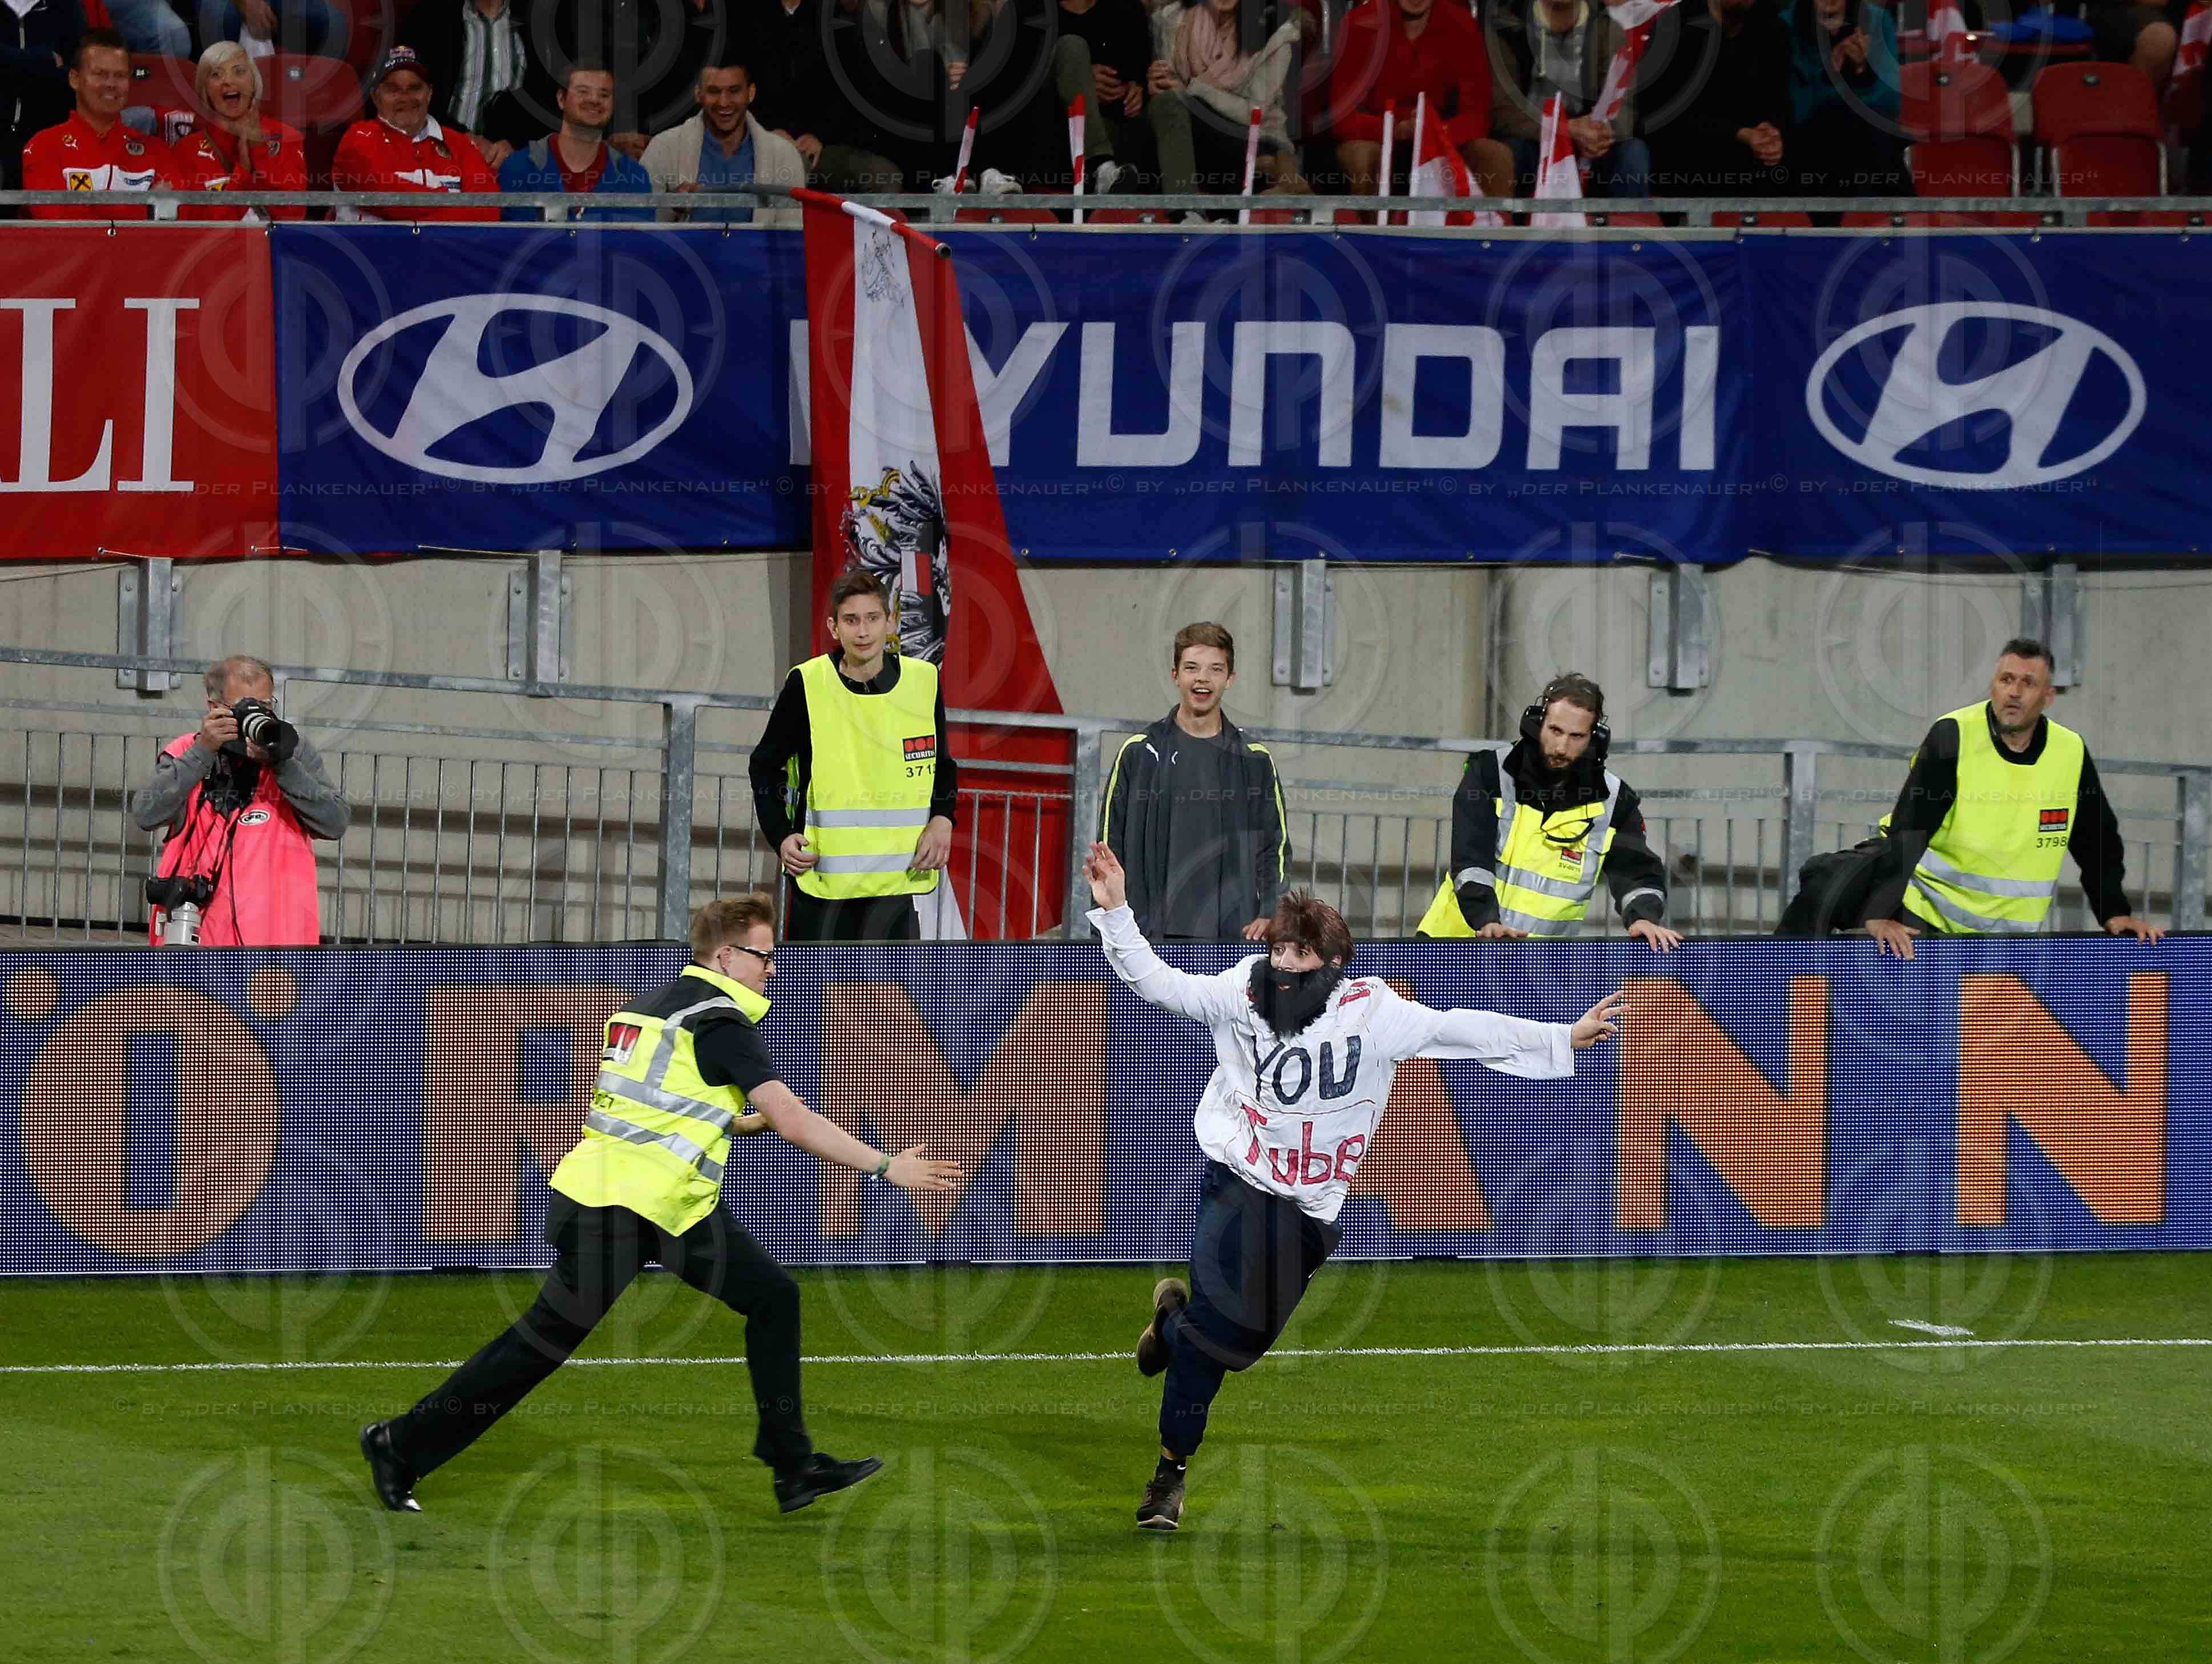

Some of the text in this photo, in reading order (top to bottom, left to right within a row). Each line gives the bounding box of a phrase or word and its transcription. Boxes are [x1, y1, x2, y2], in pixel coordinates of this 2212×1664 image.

[790, 320, 1719, 470] YUNDAI
[1252, 1035, 1362, 1106] YOU
[1241, 1102, 1366, 1186] Tube
